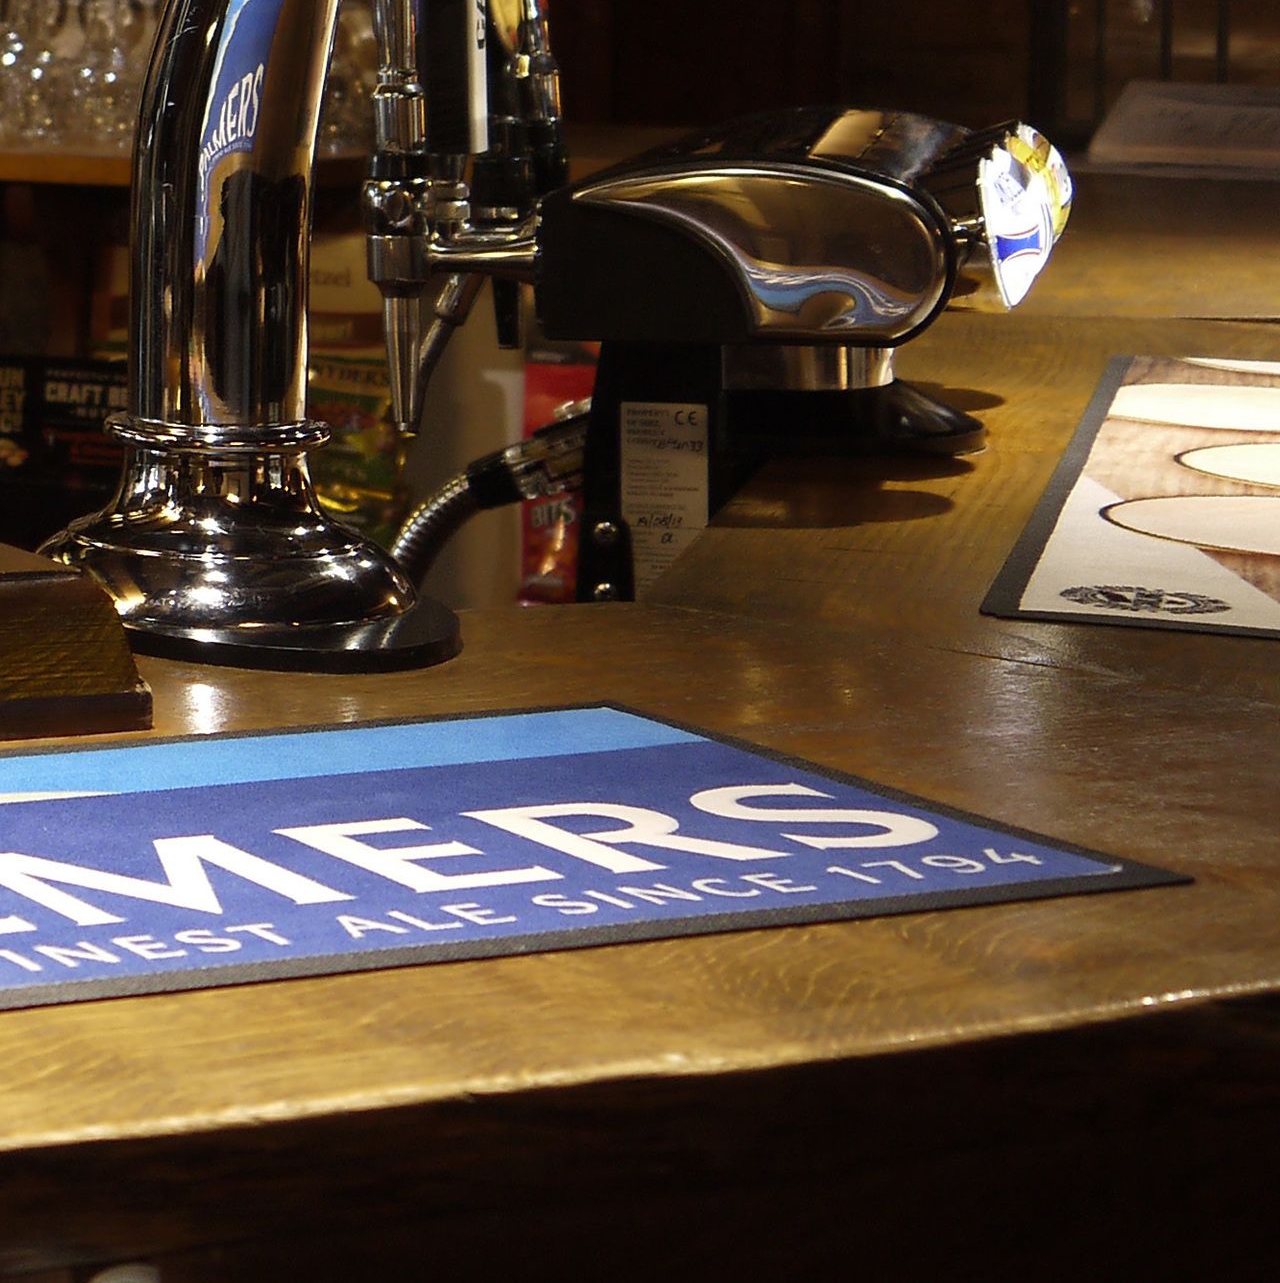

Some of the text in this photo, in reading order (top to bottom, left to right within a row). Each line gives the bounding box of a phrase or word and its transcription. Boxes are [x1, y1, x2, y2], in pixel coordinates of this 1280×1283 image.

[44, 382, 103, 405] CRAFT
[322, 902, 518, 943] ALE
[529, 871, 819, 917] SINCE
[826, 846, 1046, 885] 1794
